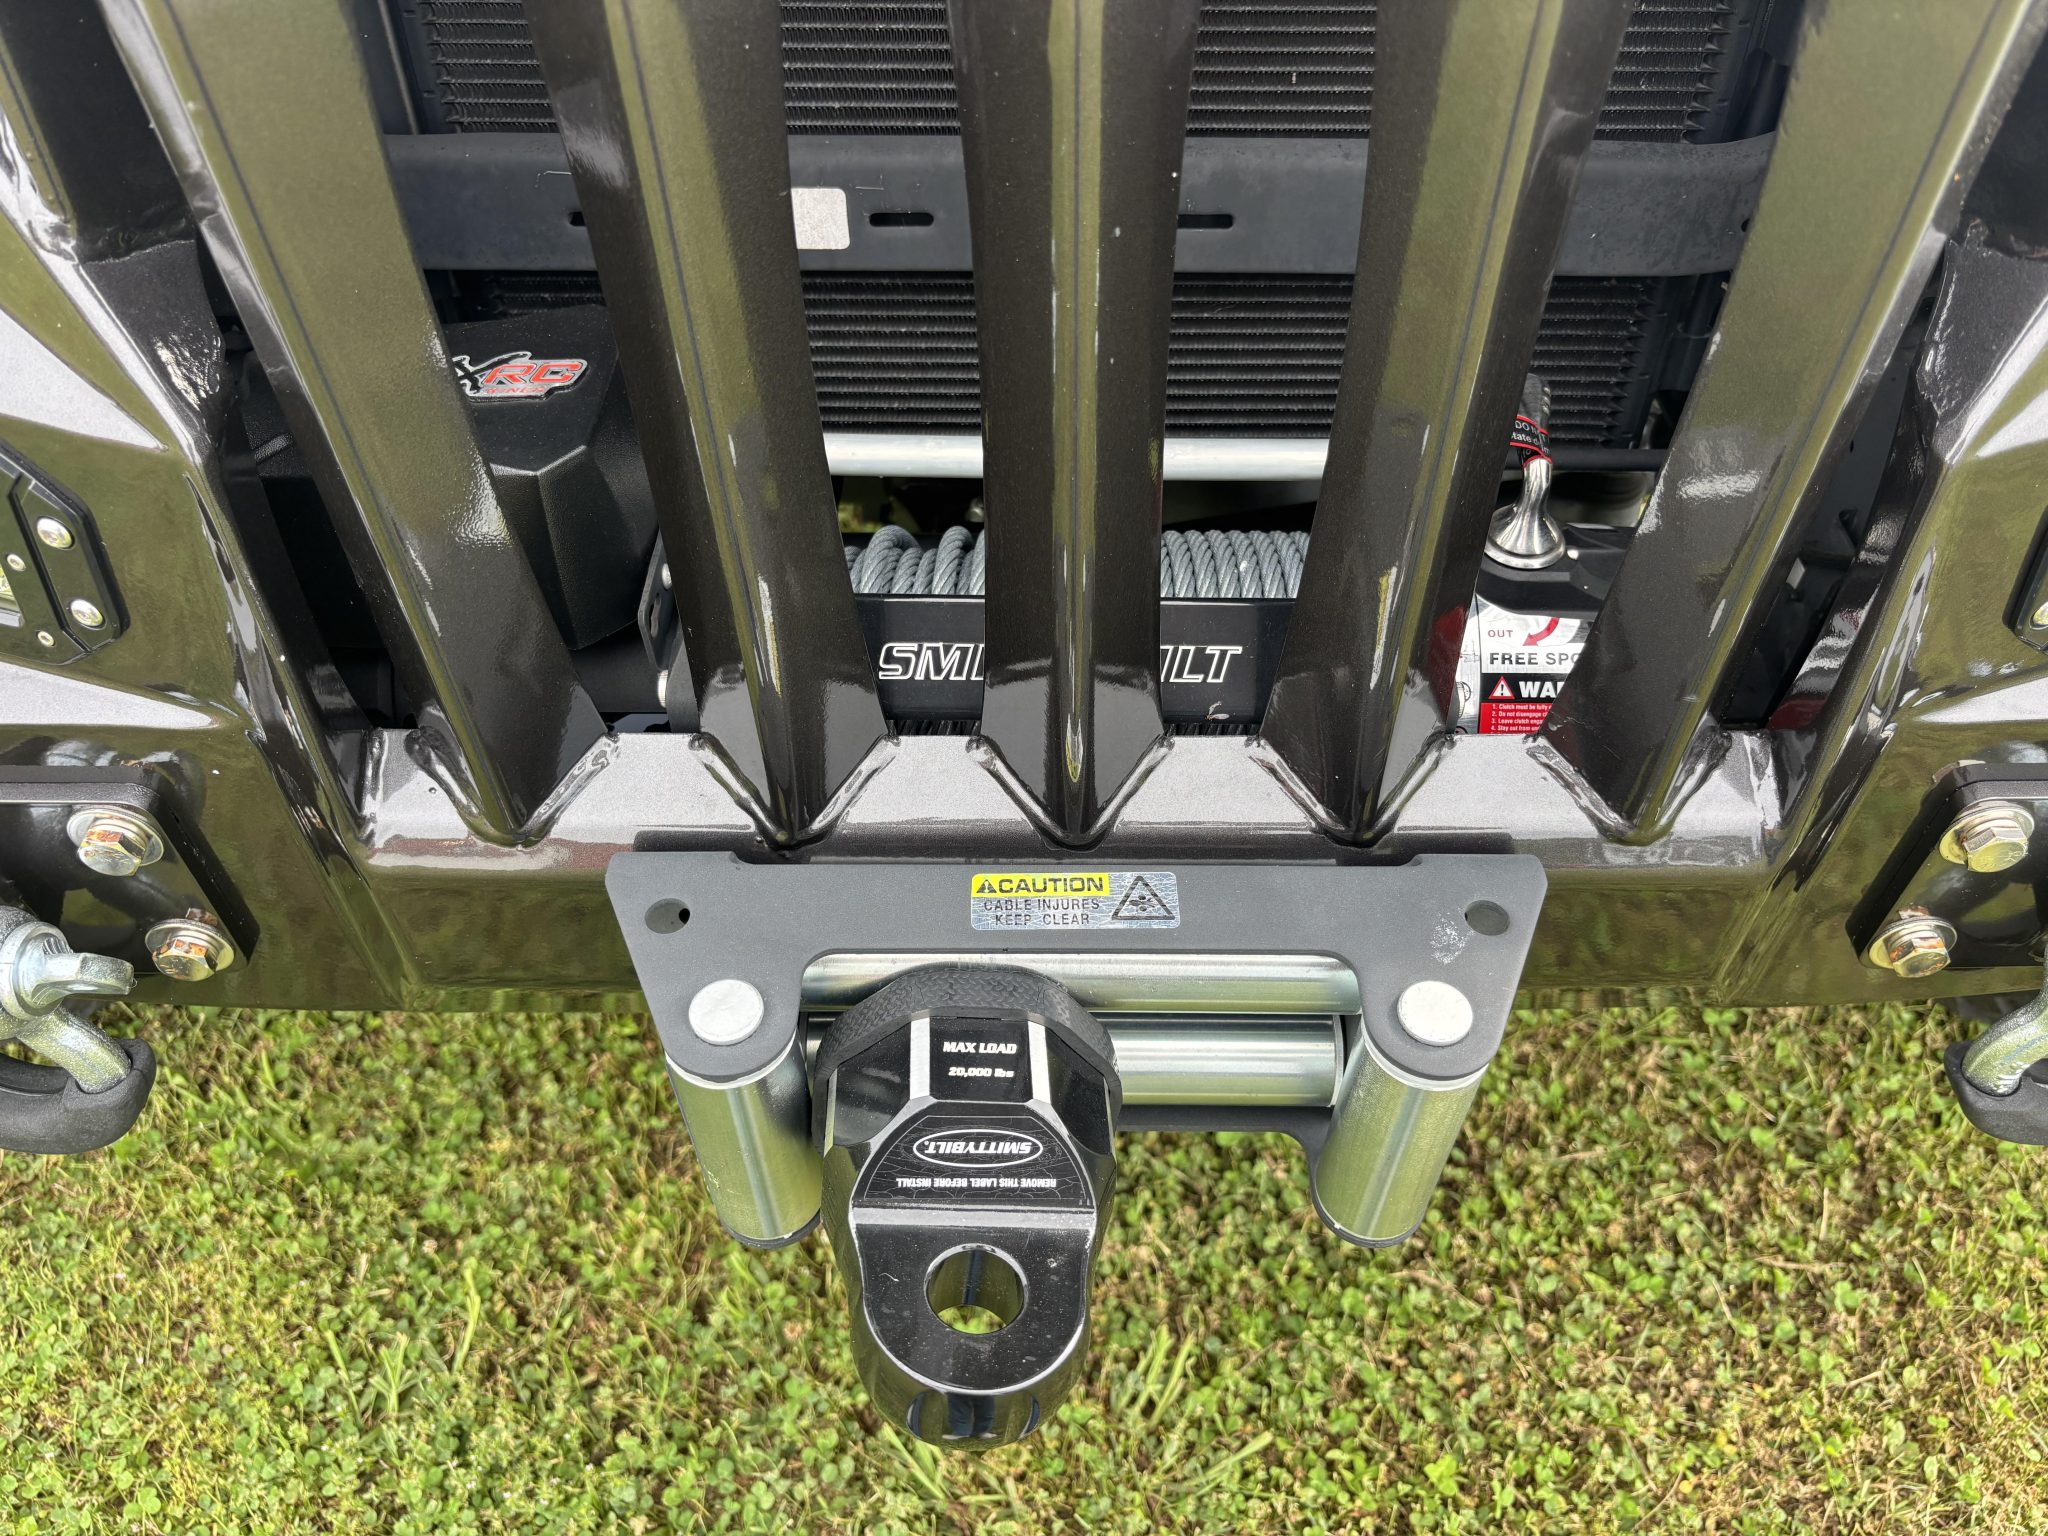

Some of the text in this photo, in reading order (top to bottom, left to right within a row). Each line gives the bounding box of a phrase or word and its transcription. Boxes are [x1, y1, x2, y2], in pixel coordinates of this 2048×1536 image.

[1514, 420, 1530, 431] DO
[1510, 431, 1532, 443] tate
[1487, 629, 1514, 638] OUT
[1489, 652, 1539, 666] FREE
[1518, 681, 1565, 699] WA
[1536, 704, 1548, 712] fully
[998, 877, 1104, 894] CAUTION
[983, 898, 1100, 911] CABLE INJURES
[995, 913, 1090, 926] KEEP CLEAR
[943, 1041, 1018, 1054] MAX LOAD
[948, 1066, 1015, 1078] 20,000 lbs
[895, 1177, 1057, 1188] REMOVE THIS LABEL BEFORE INSTALL
